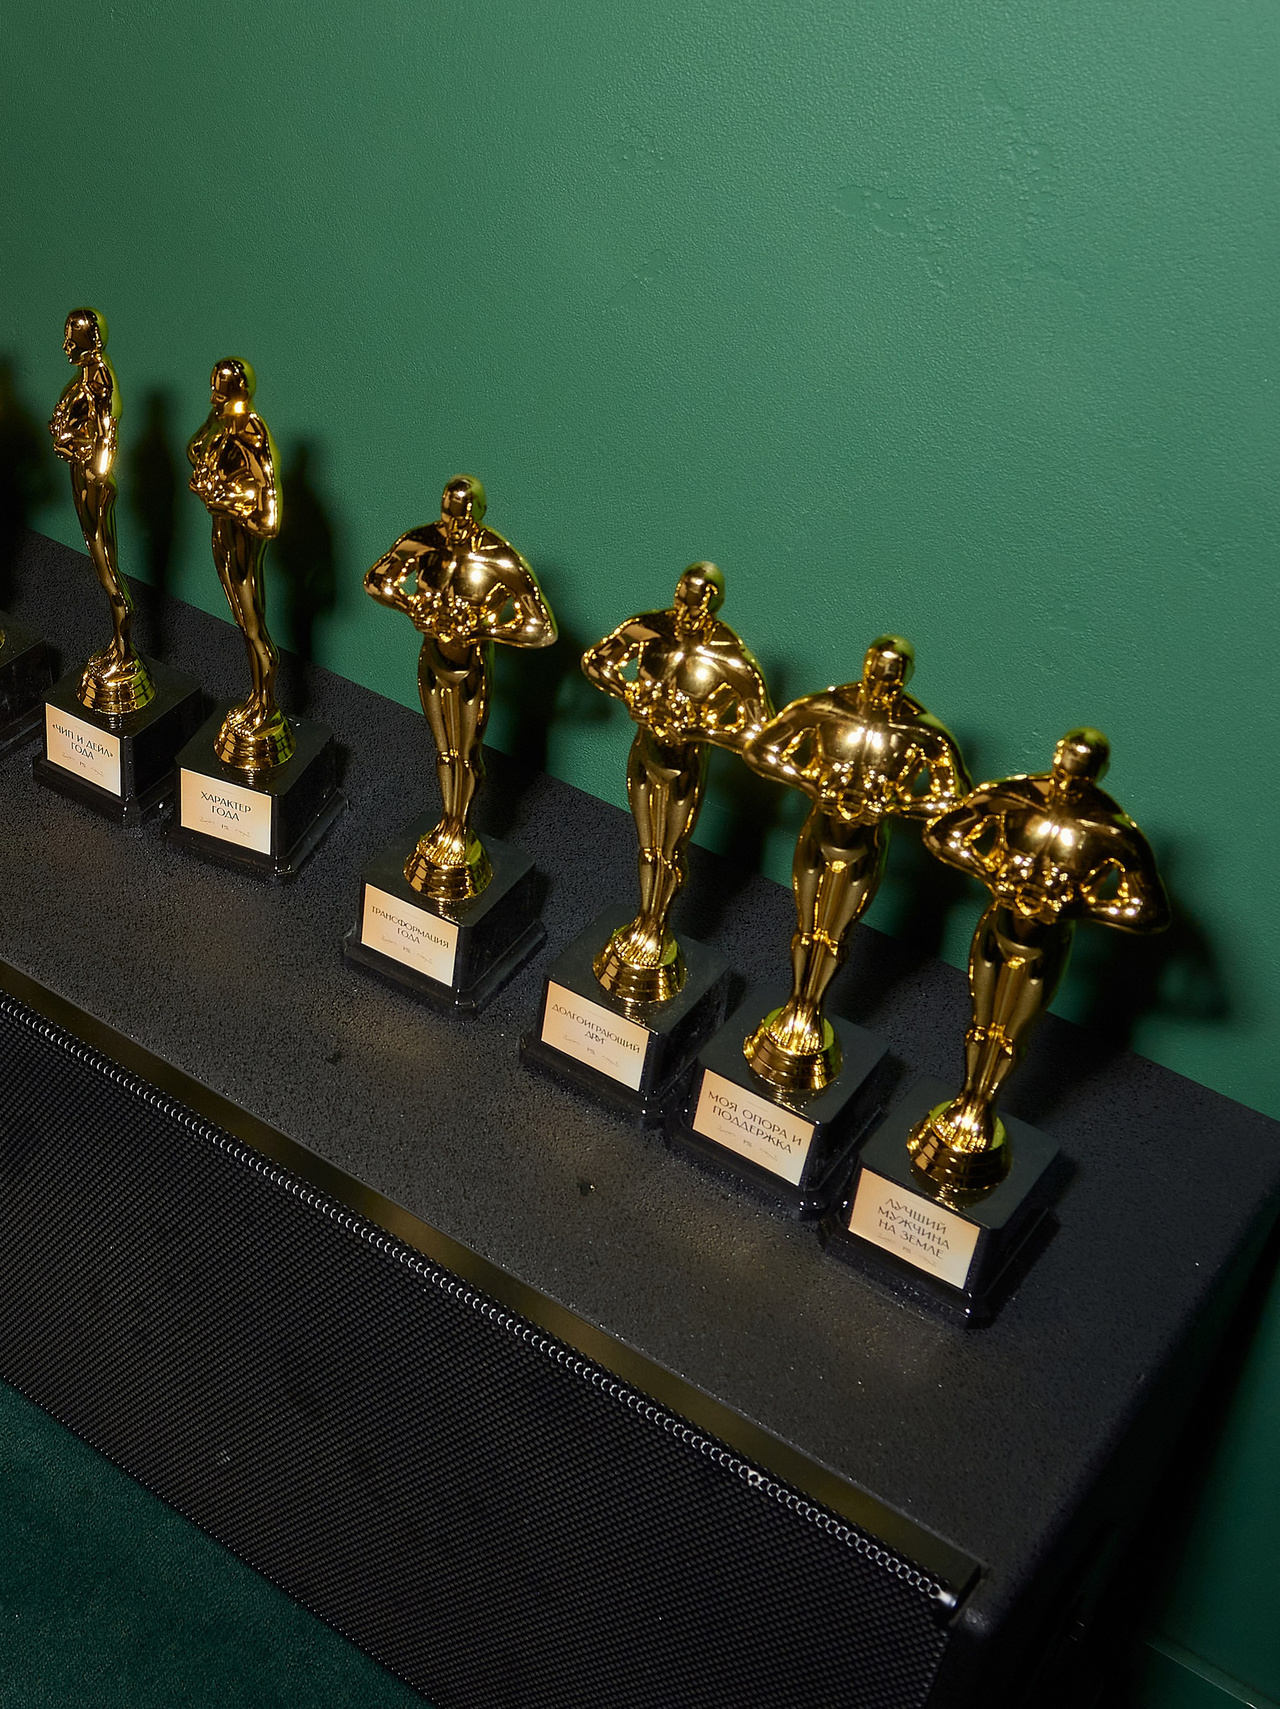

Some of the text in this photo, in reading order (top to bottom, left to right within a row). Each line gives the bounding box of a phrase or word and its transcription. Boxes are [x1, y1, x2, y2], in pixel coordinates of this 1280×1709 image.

[52, 724, 113, 758] «ЧИП И ДЕЙЛ»
[71, 742, 94, 760] ГОДА
[201, 791, 251, 813] ХАРАКТЕР
[211, 805, 240, 821] ГОДА
[371, 906, 449, 948] ТРАНСФОРМАЦИЯ
[397, 928, 420, 944] ГОДА
[552, 1003, 640, 1053] ДОЛГОИГРАЮЩИЙ
[585, 1031, 606, 1045] ДРУГ
[708, 1091, 802, 1146] МОЯ ОПОРА И
[712, 1105, 792, 1154] ПОДДЕРЖКА
[878, 1206, 950, 1250] МУЖЧИНА
[886, 1198, 947, 1235] ЛУЧШИЙ
[878, 1219, 896, 1235] НА
[900, 1231, 944, 1259] ЗЕМЛЕ
